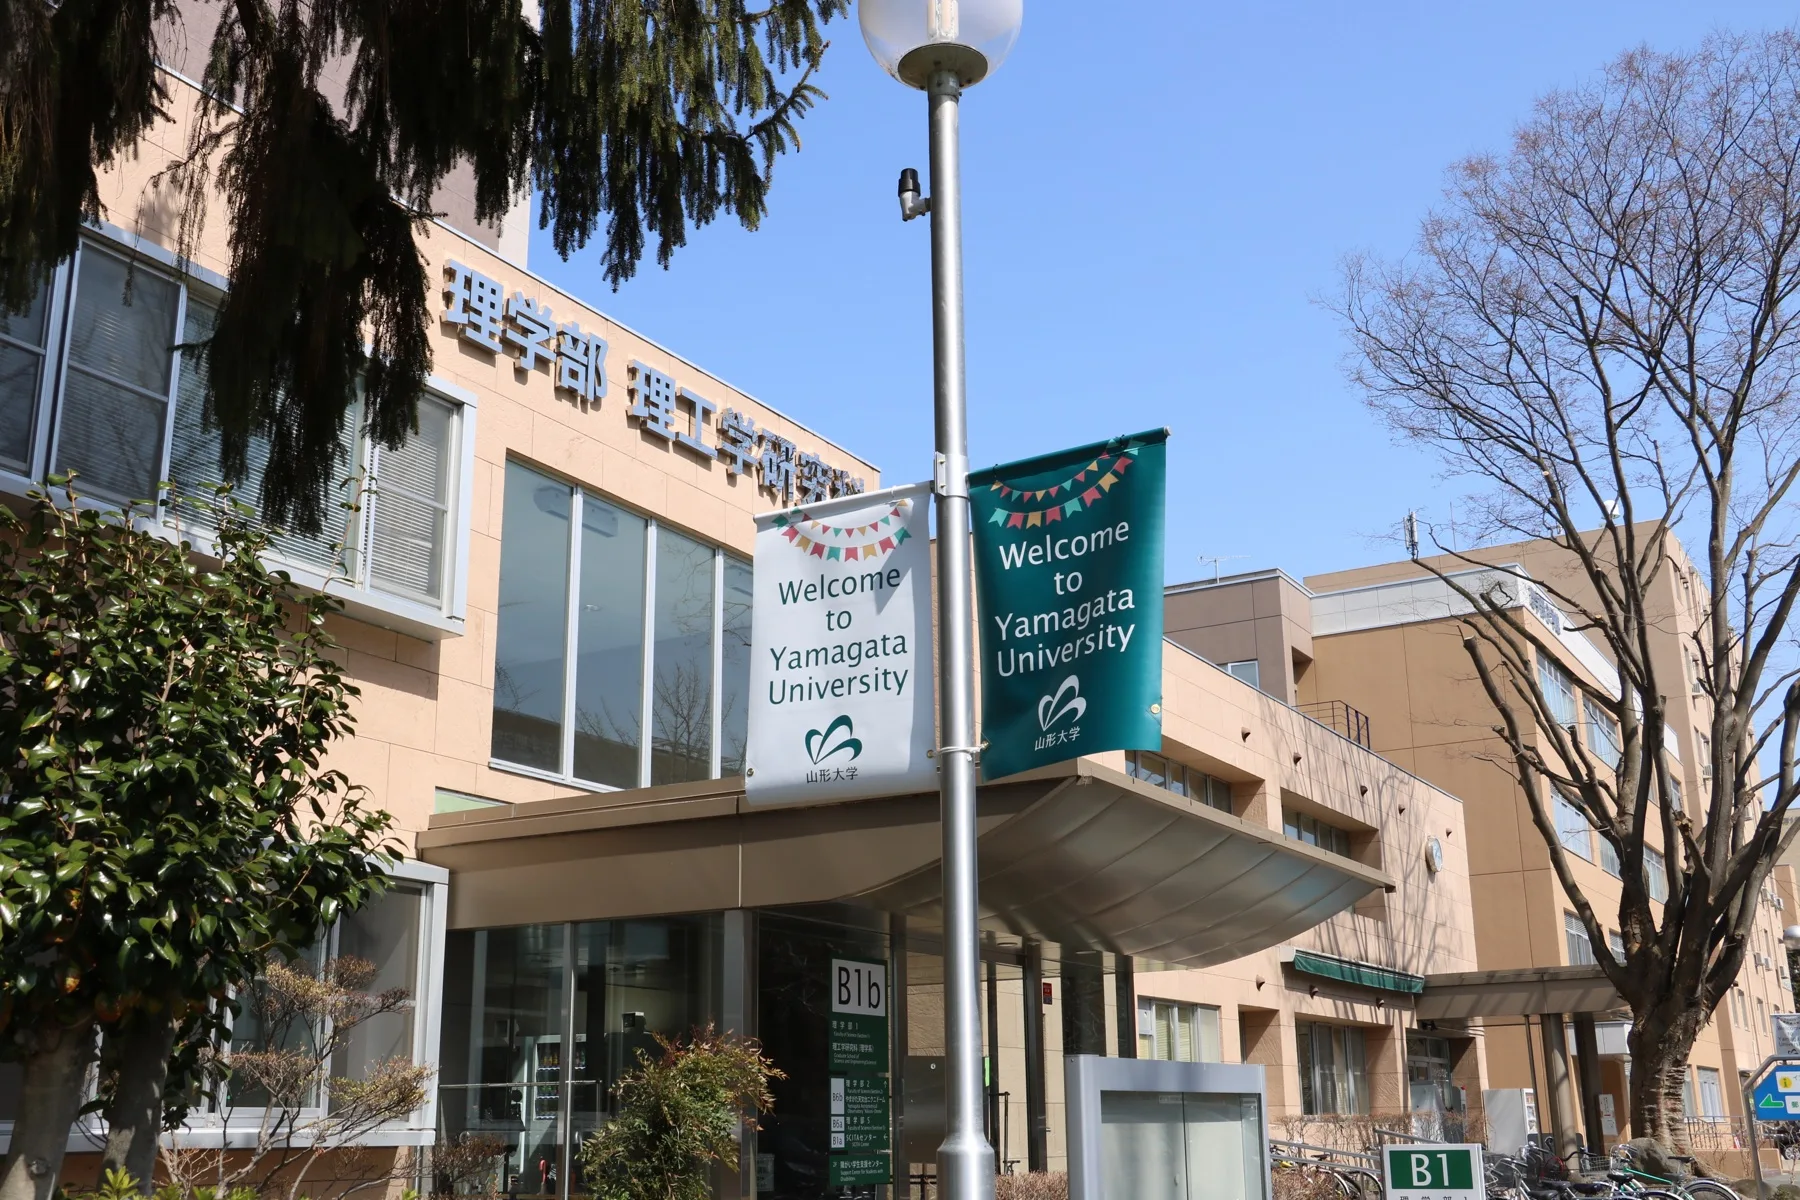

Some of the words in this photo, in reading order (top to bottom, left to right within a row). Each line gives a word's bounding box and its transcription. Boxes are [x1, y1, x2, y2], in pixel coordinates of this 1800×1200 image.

[442, 258, 608, 402] 理学部
[999, 520, 1130, 570] Welcome
[778, 567, 901, 605] Welcome
[1053, 570, 1083, 596] to
[825, 607, 853, 632] to
[994, 587, 1136, 642] Yamagata
[769, 632, 908, 672] Yamagata
[997, 623, 1136, 678] University
[768, 666, 909, 706] University
[1034, 725, 1082, 753] 山形大学
[805, 766, 859, 785] 山形大学
[838, 966, 881, 1009] B1b
[1410, 1153, 1449, 1187] B1
